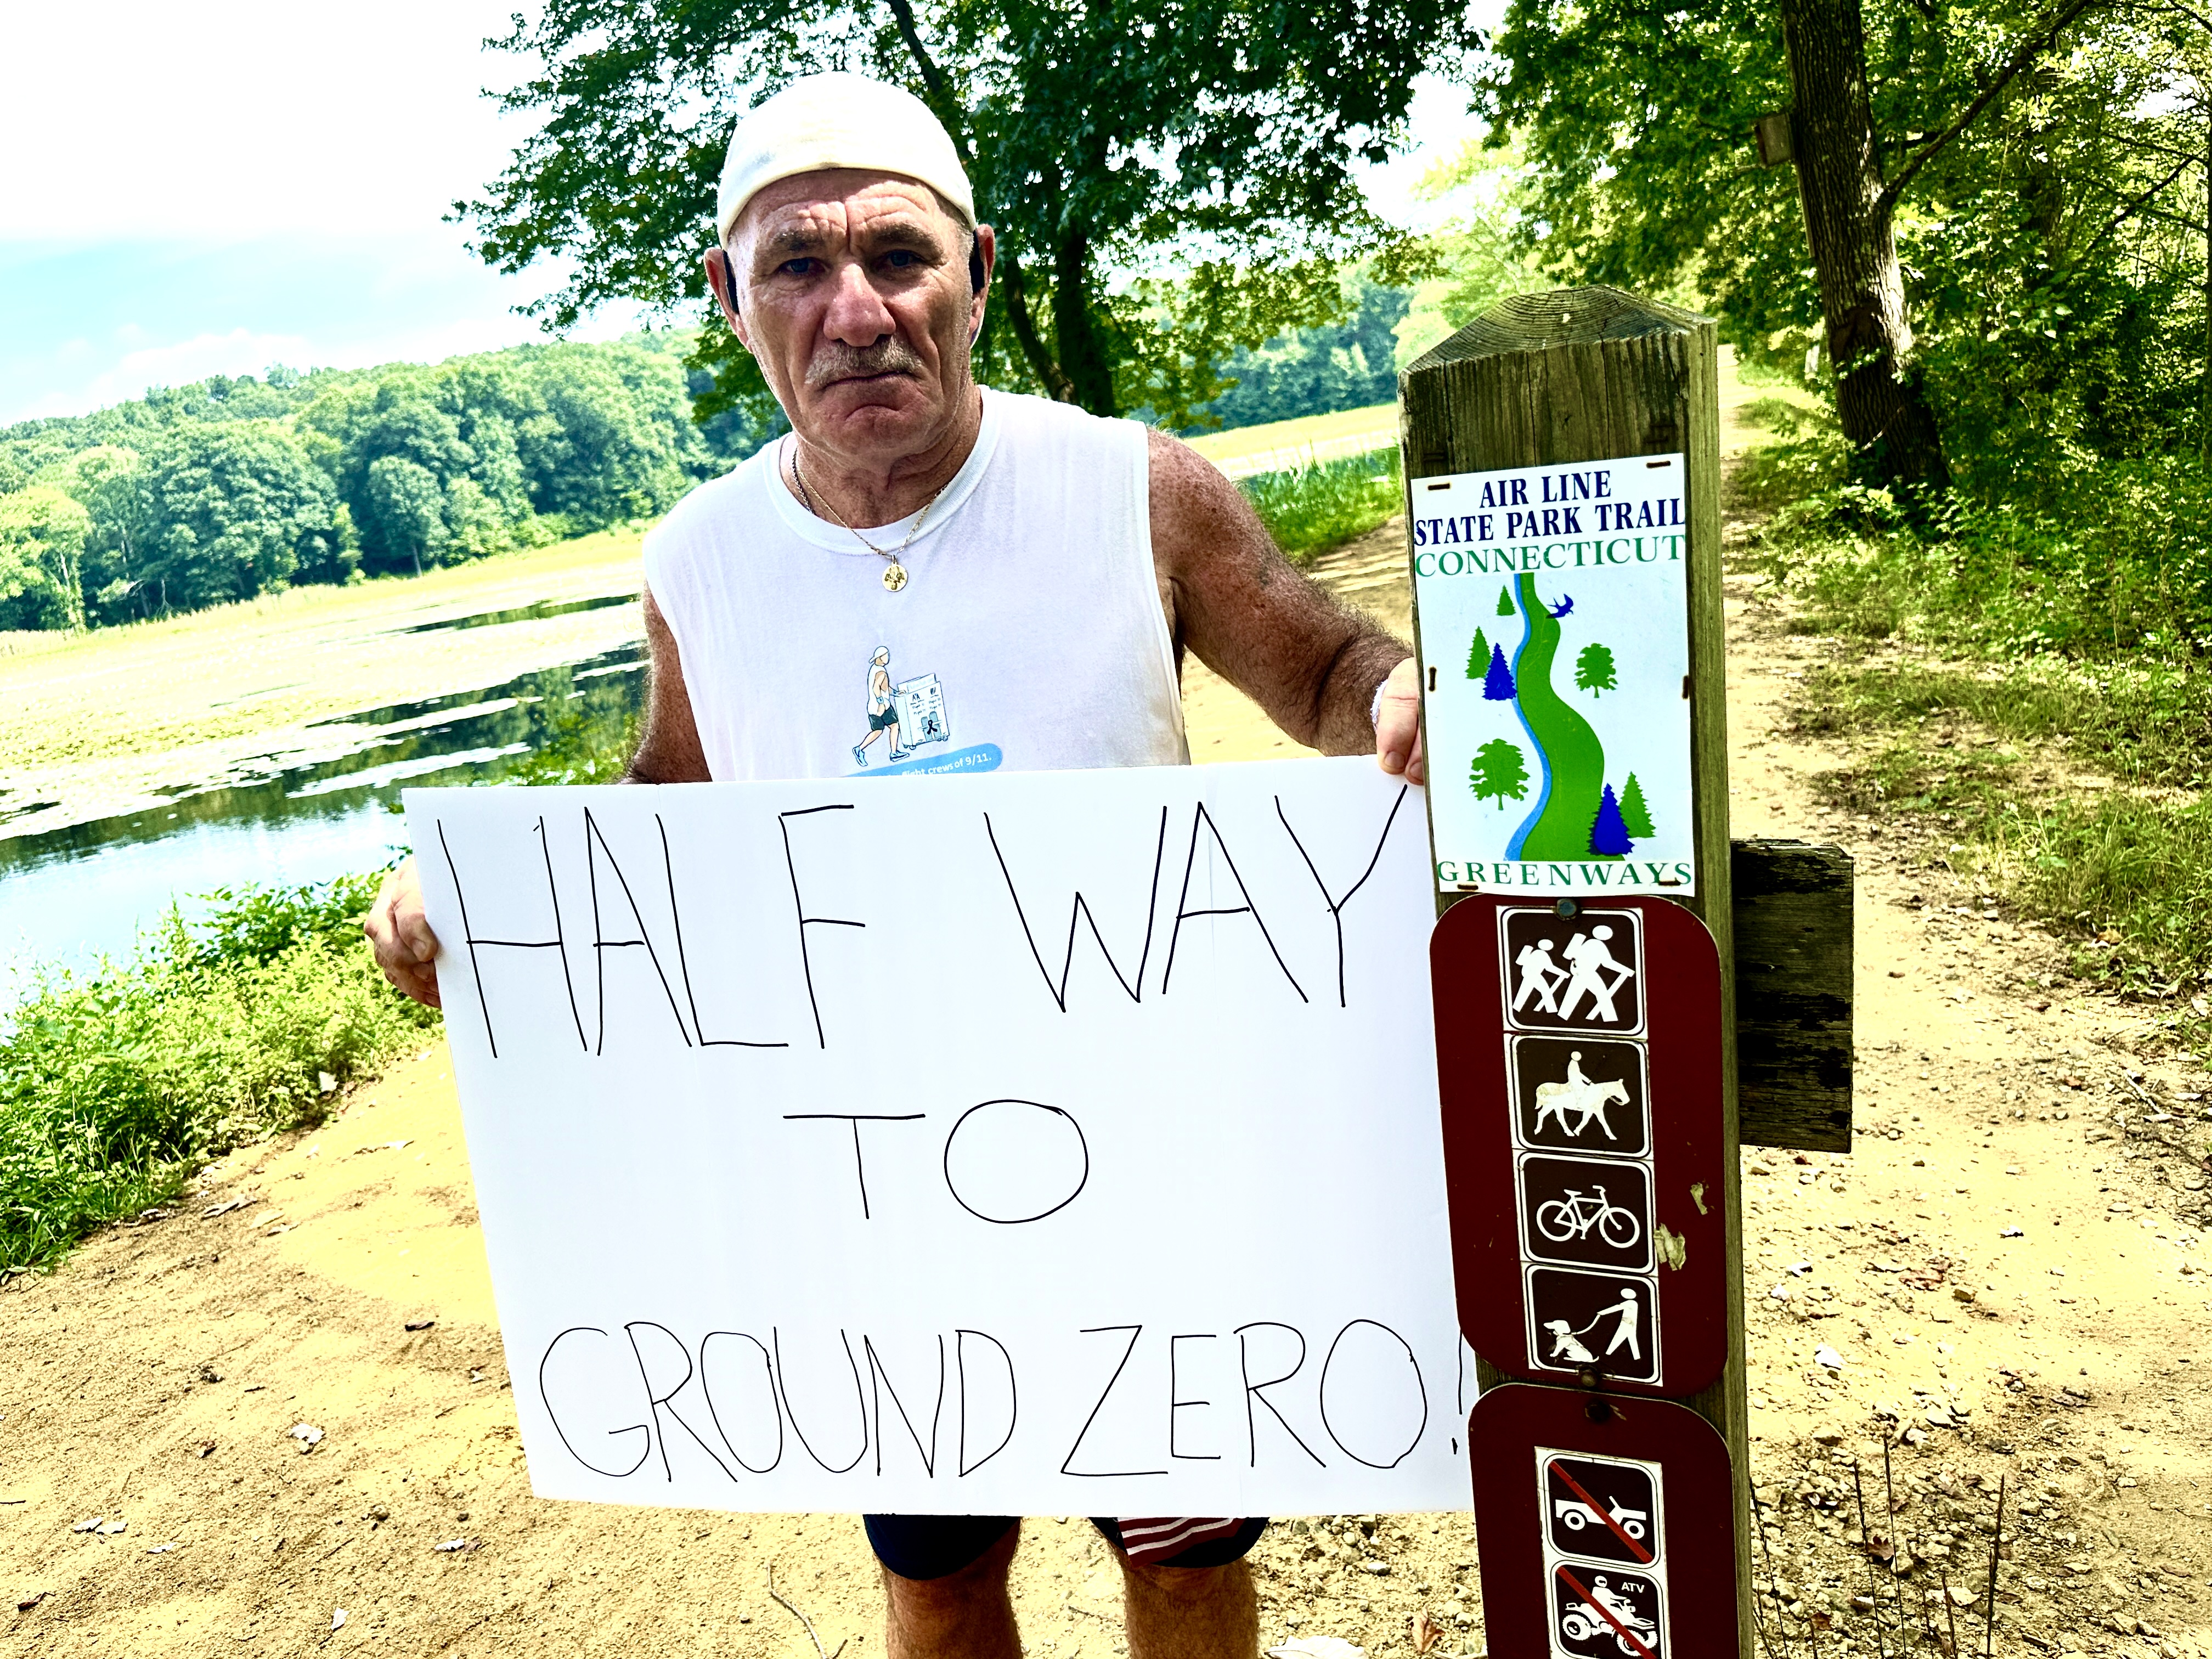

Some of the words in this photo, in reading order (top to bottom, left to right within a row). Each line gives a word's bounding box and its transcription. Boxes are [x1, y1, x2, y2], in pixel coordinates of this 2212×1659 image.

[1479, 478, 1529, 509] AIR
[1542, 470, 1611, 503] LINE
[1414, 514, 1493, 546] STATE
[1507, 506, 1582, 539] PARK
[1595, 498, 1685, 531] TRAIL
[1415, 535, 1685, 577] CONNECTICUT
[928, 763, 953, 774] crews
[955, 758, 963, 768] of
[965, 753, 992, 766] 9/11.
[1437, 861, 1692, 885] GREENWAYS
[437, 805, 866, 1058] HALF
[984, 784, 1408, 1013] WAY
[783, 1099, 1089, 1224] TO
[540, 1322, 1016, 1482] GROUND
[1061, 1319, 1462, 1476] ZERO!
[1621, 1582, 1645, 1593] ATV
